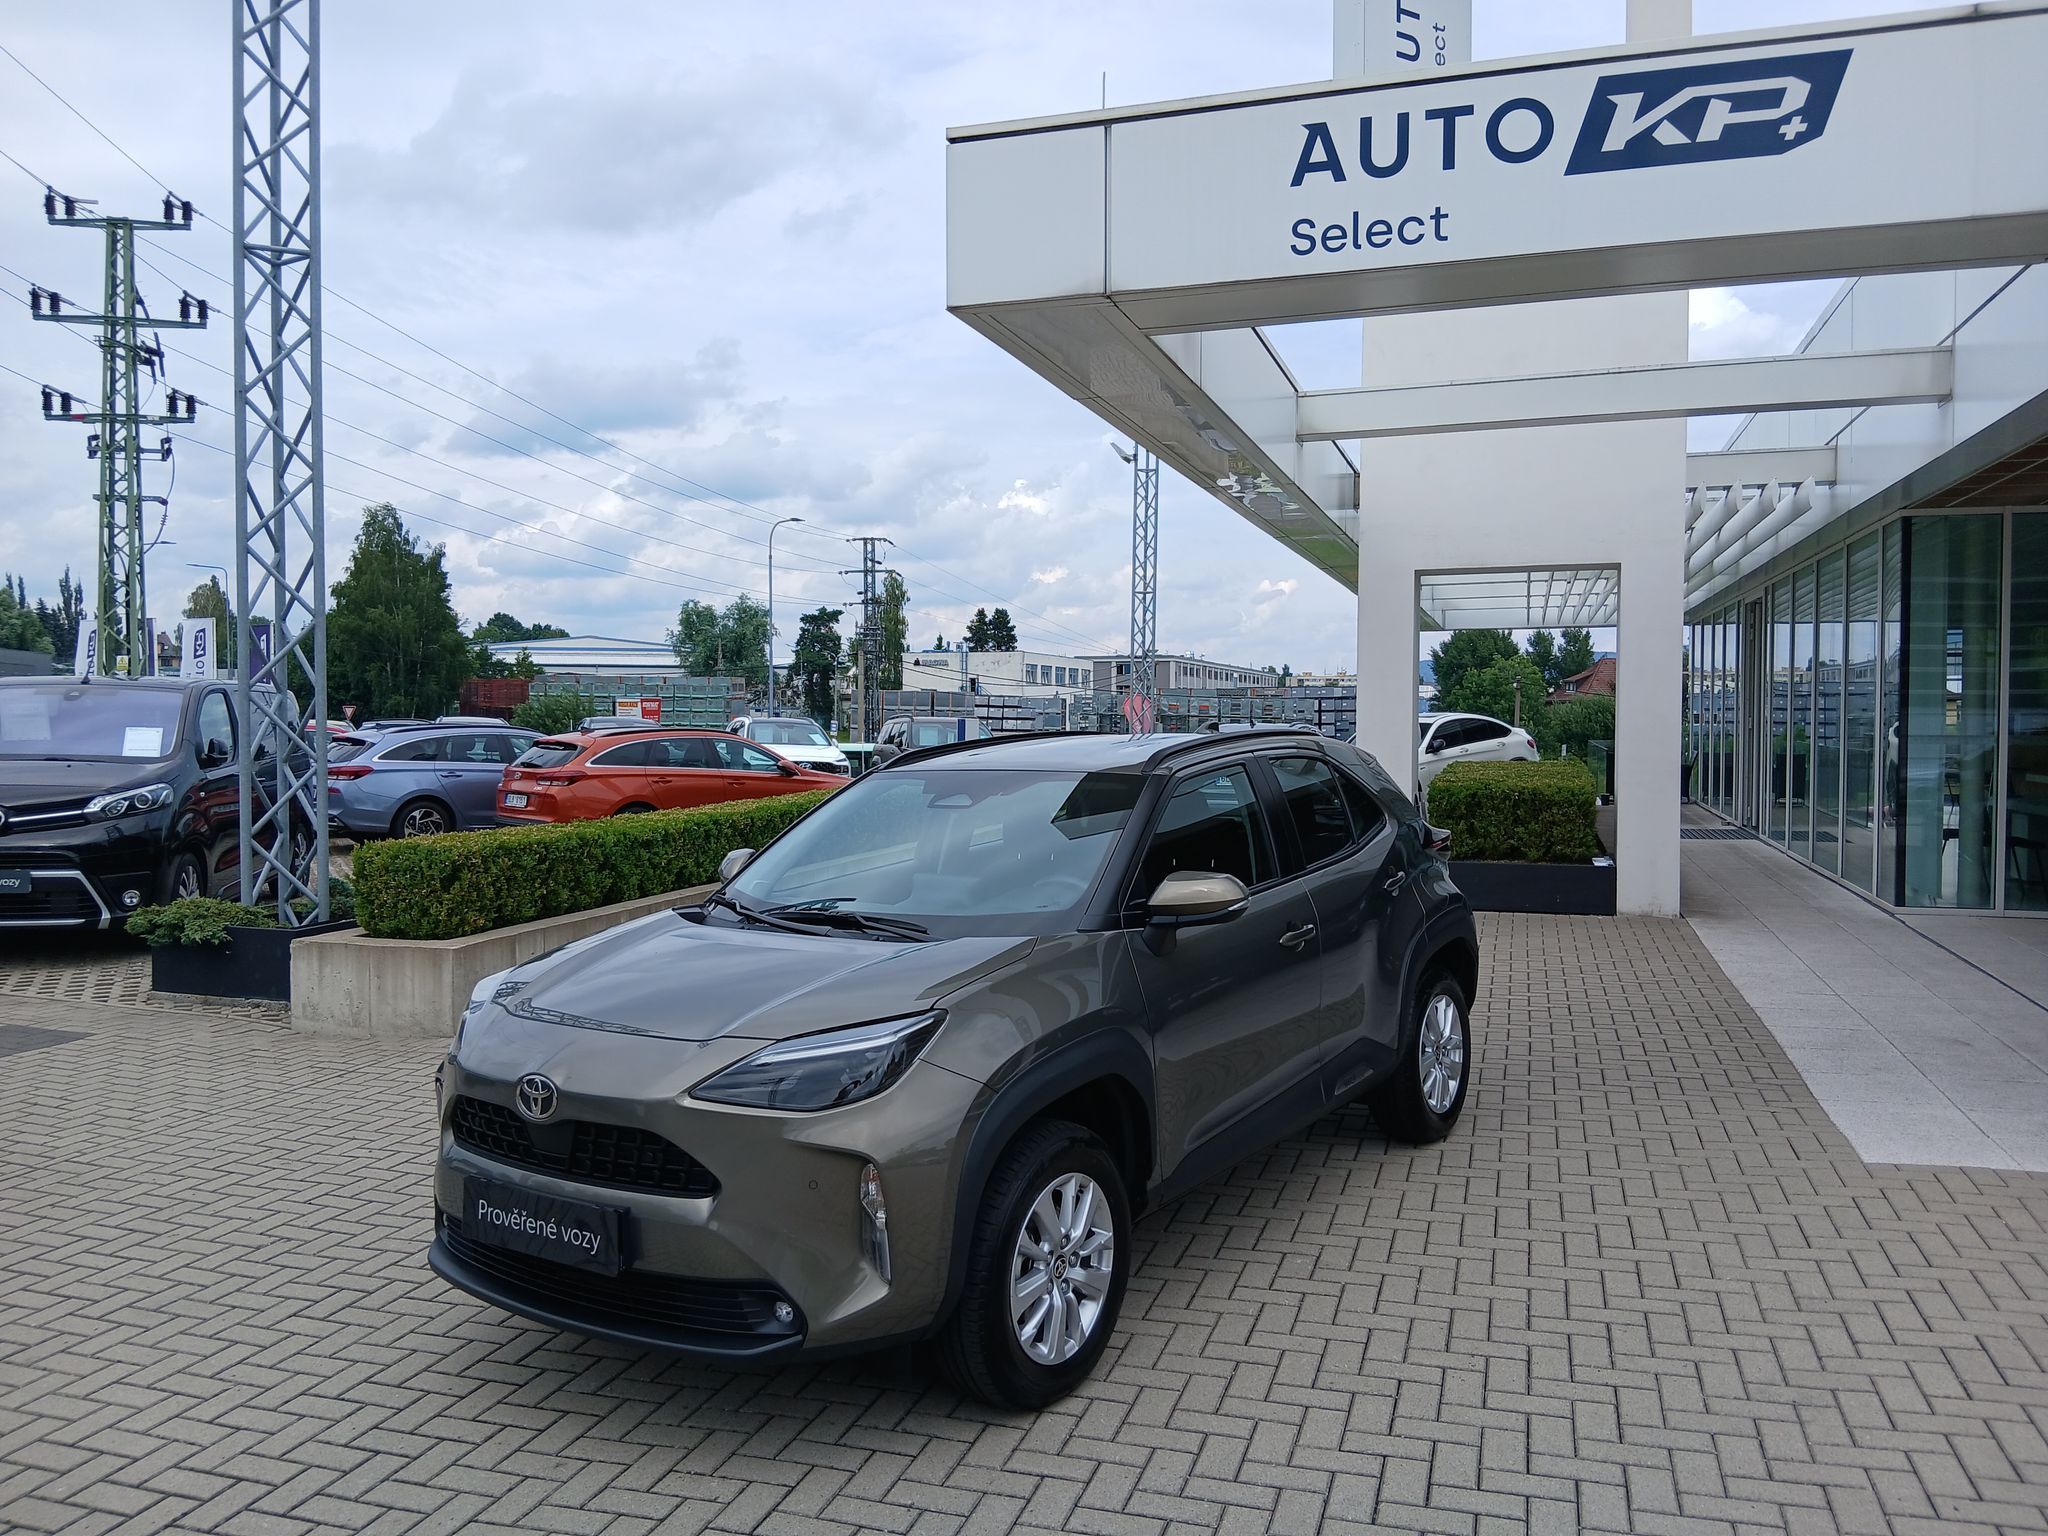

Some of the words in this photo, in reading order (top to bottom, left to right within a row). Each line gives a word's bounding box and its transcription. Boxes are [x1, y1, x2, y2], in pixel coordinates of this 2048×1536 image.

[1432, 22, 1446, 66] ect
[1290, 97, 1555, 187] AUTO
[1290, 206, 1450, 256] Select
[478, 1199, 557, 1239] Prověřené
[561, 1226, 601, 1255] vozy
